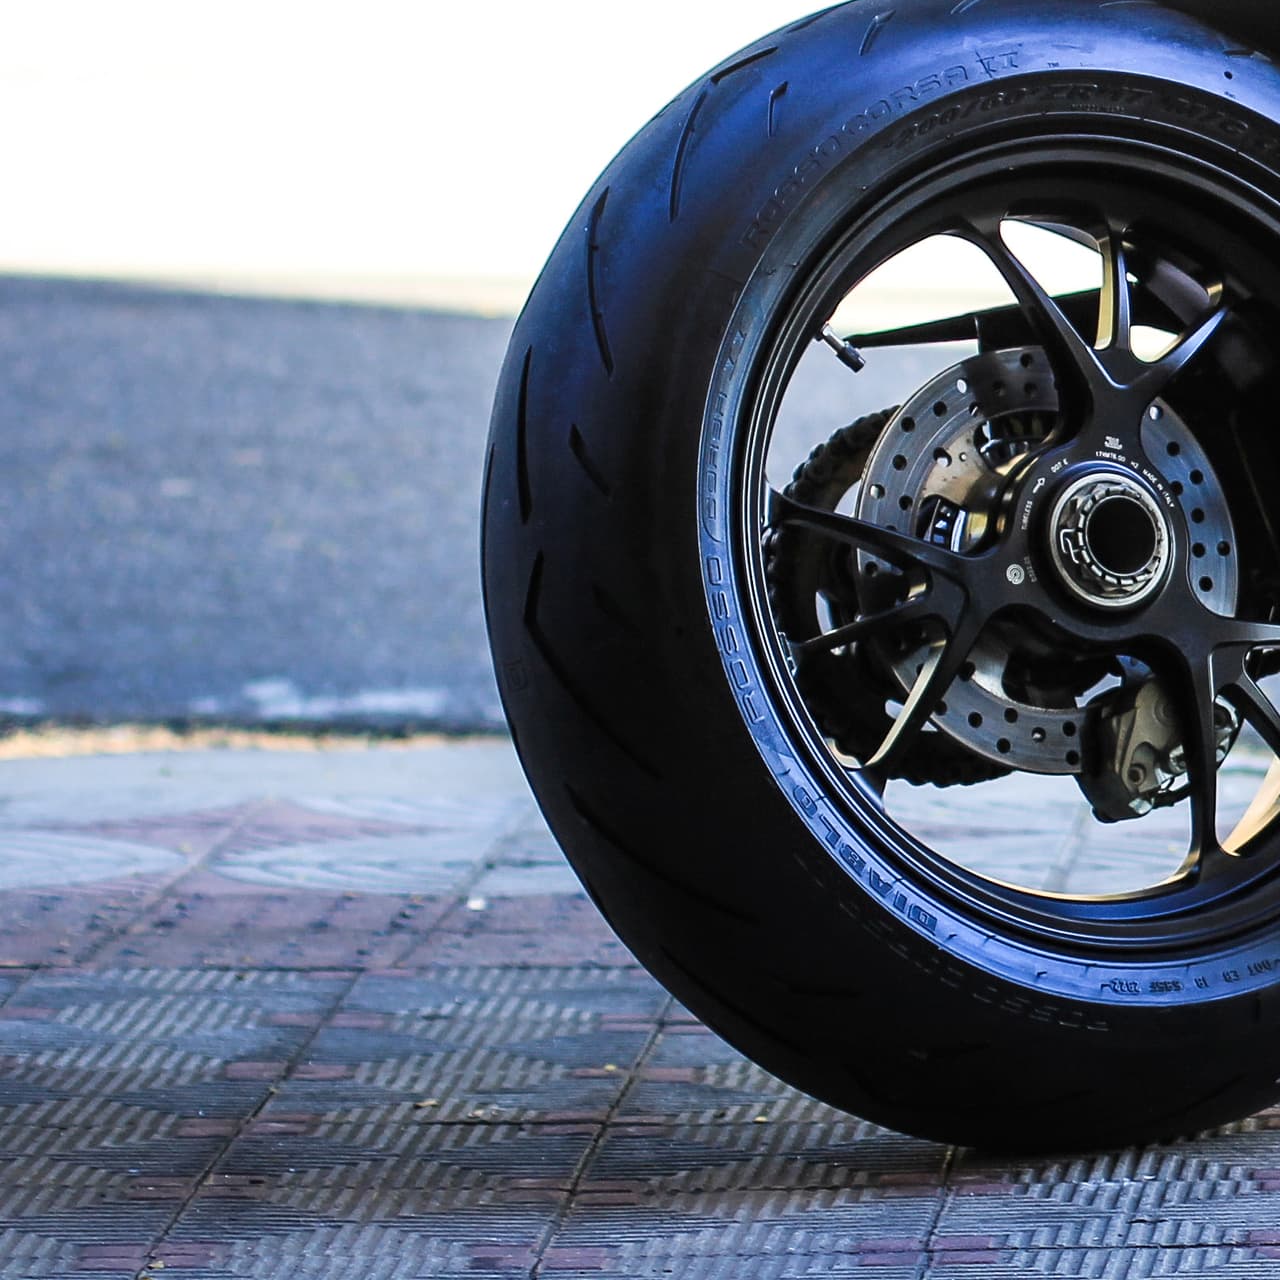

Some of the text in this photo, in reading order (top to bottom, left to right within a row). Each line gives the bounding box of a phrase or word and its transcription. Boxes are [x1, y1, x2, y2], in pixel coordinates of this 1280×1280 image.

[842, 65, 970, 141] CORSA
[703, 390, 729, 521] CORSA
[706, 555, 766, 724] ROSSO
[791, 782, 941, 937] DIABLO
